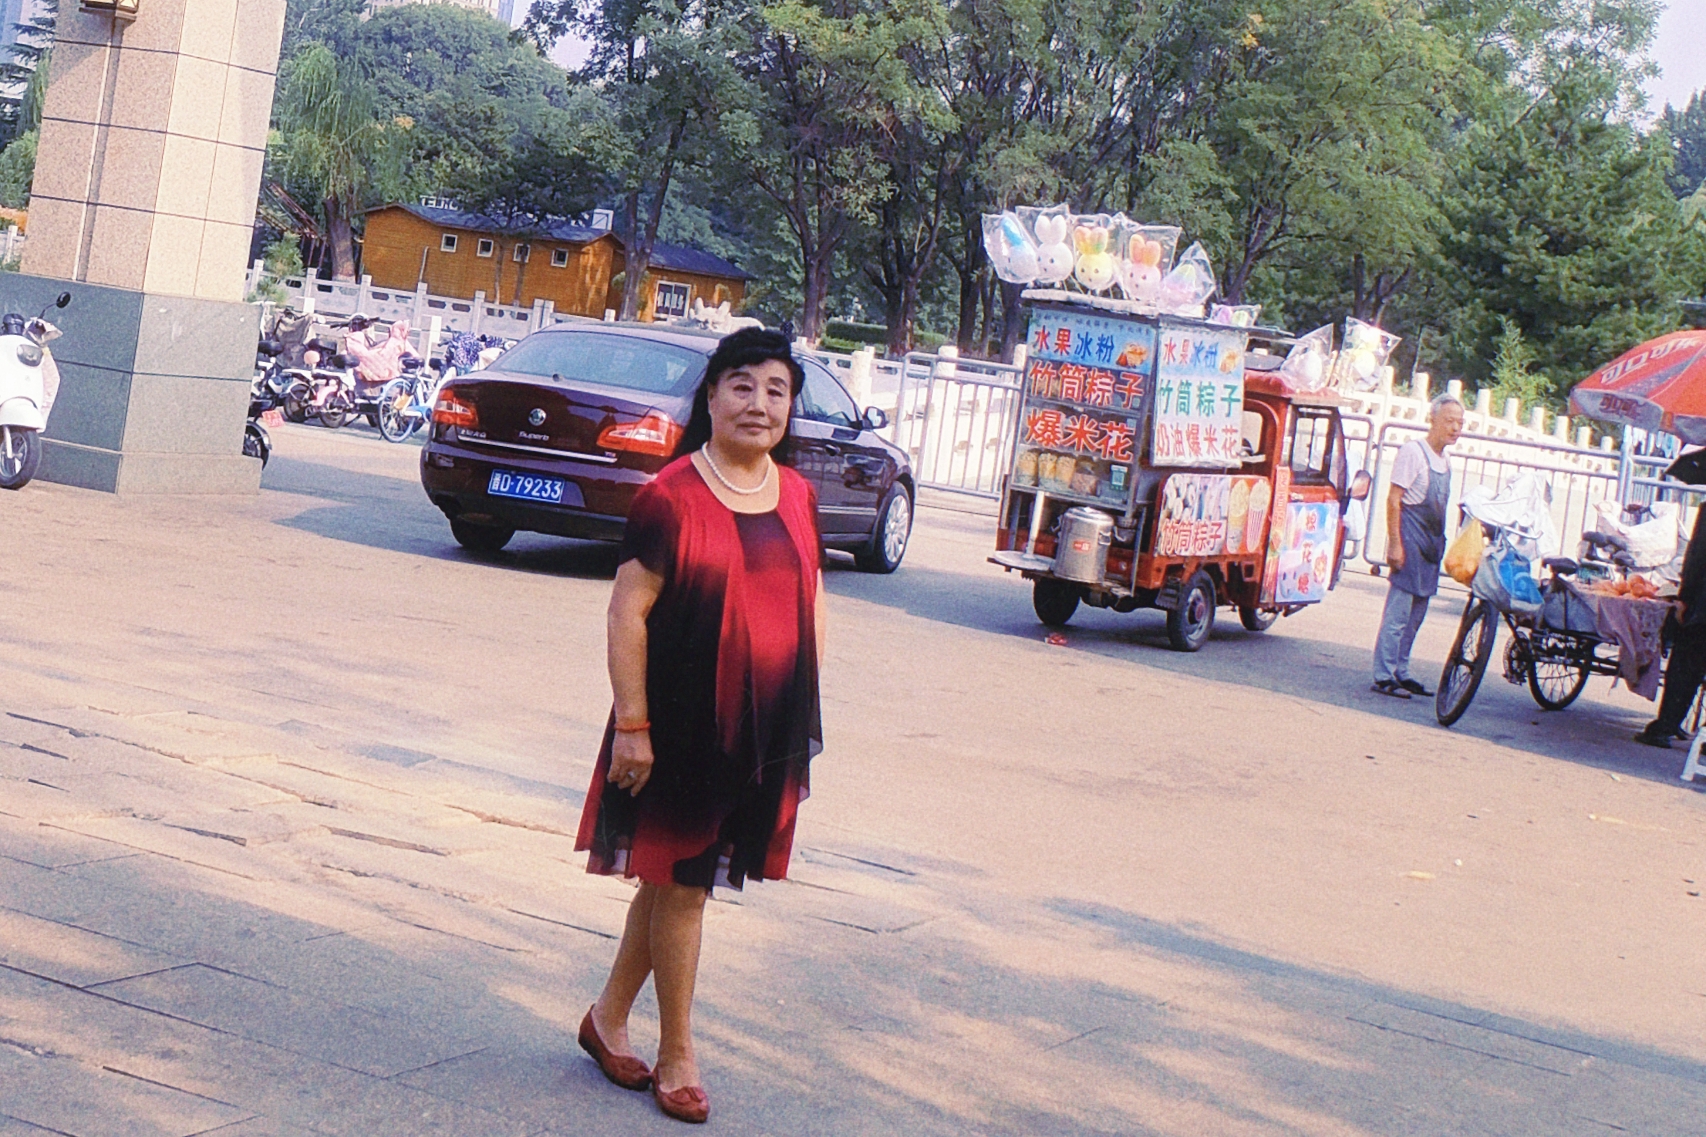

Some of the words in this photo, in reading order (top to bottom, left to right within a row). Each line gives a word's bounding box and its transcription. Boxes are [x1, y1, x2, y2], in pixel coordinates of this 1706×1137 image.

[1033, 325, 1115, 363] 水果冰粉
[1163, 336, 1219, 368] 水果冰粉
[1028, 361, 1144, 410] 竹筒粽子
[1158, 378, 1241, 418] 竹筒粽子
[518, 430, 549, 441] Superb
[1025, 408, 1136, 463] 爆米花
[1156, 422, 1239, 460] 奶油爆米花
[1161, 518, 1223, 555] 竹筒粽子
